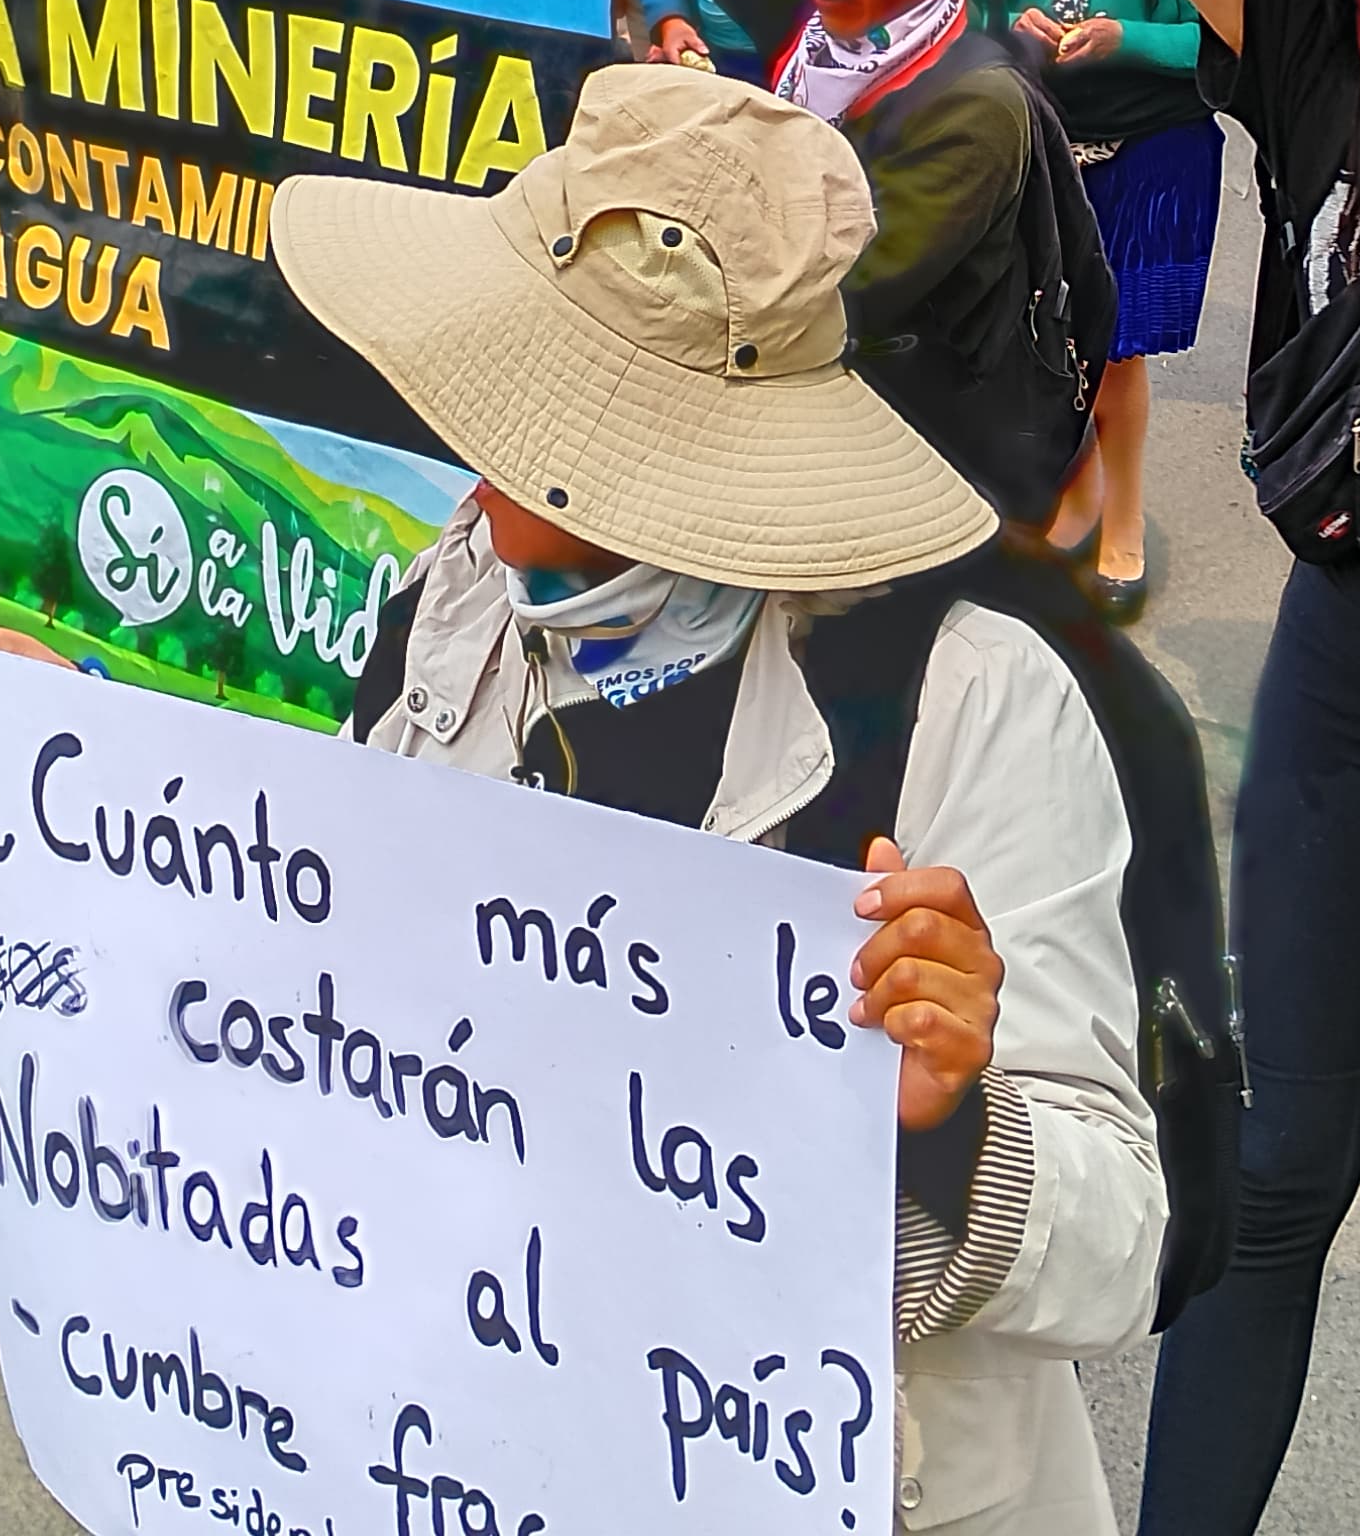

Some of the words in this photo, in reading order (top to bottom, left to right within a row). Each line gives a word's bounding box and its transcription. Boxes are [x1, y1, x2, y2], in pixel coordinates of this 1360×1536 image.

[99, 484, 180, 604] Sí
[198, 558, 253, 627] la
[209, 529, 247, 568] a
[262, 520, 399, 678] Vid
[474, 893, 670, 1016] más
[775, 921, 848, 1051] le
[171, 971, 526, 1166] costarán
[628, 1070, 767, 1244] las
[466, 1225, 560, 1368] al
[645, 1346, 874, 1532] país?
